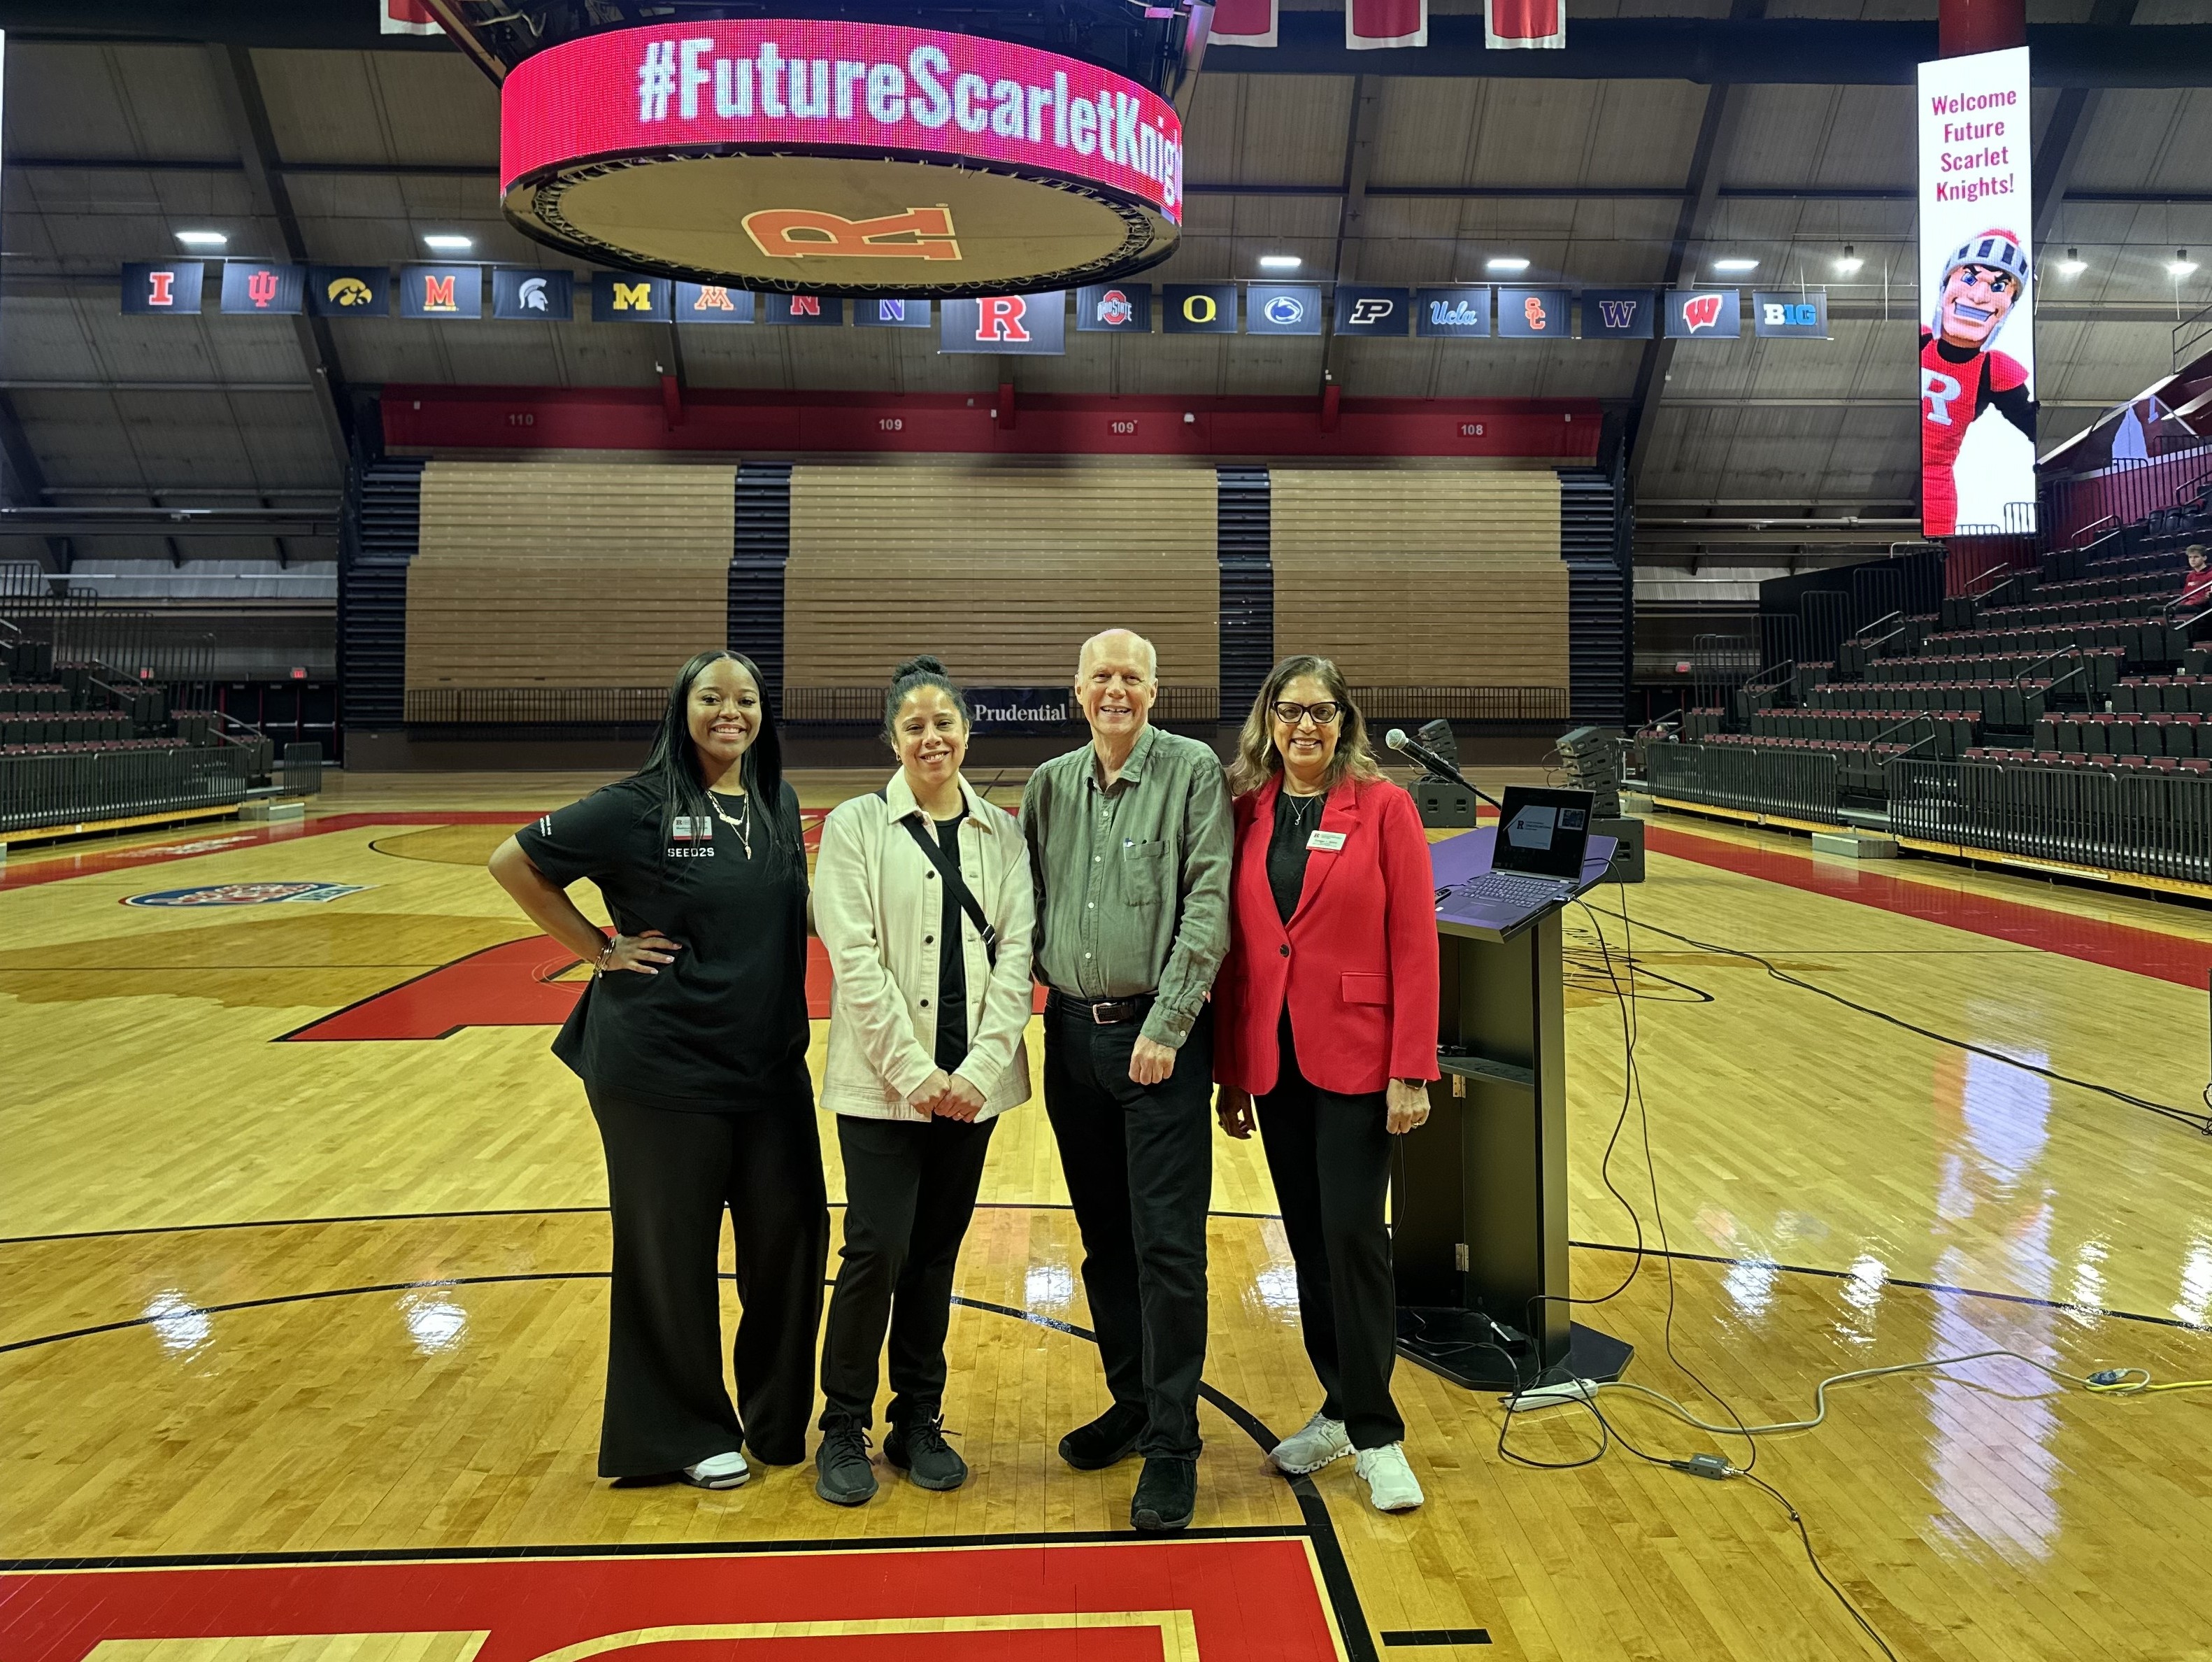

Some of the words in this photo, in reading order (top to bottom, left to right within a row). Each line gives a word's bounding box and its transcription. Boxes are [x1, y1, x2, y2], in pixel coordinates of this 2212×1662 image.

[1932, 90, 2016, 115] Welcome
[1944, 122, 2004, 143] Future
[1941, 146, 2008, 172] Scarlet
[1936, 173, 2014, 202] Knights!
[741, 208, 962, 260] R
[149, 271, 173, 305] I
[425, 276, 455, 306] M
[613, 283, 651, 310] M
[694, 285, 734, 311] M
[790, 294, 820, 315] N
[879, 299, 904, 320] N
[1183, 294, 1216, 322] O
[1349, 299, 1394, 324] P
[1599, 301, 1636, 327] W
[1683, 294, 1723, 334] W
[976, 294, 1029, 341] R
[1921, 367, 1962, 426] R
[508, 413, 534, 425] 110
[878, 418, 902, 430] 109
[1111, 422, 1134, 433] 109
[1461, 424, 1483, 435] 108
[974, 704, 1067, 721] Prudential
[1516, 820, 1525, 830] R
[667, 847, 715, 858] SEED2S
